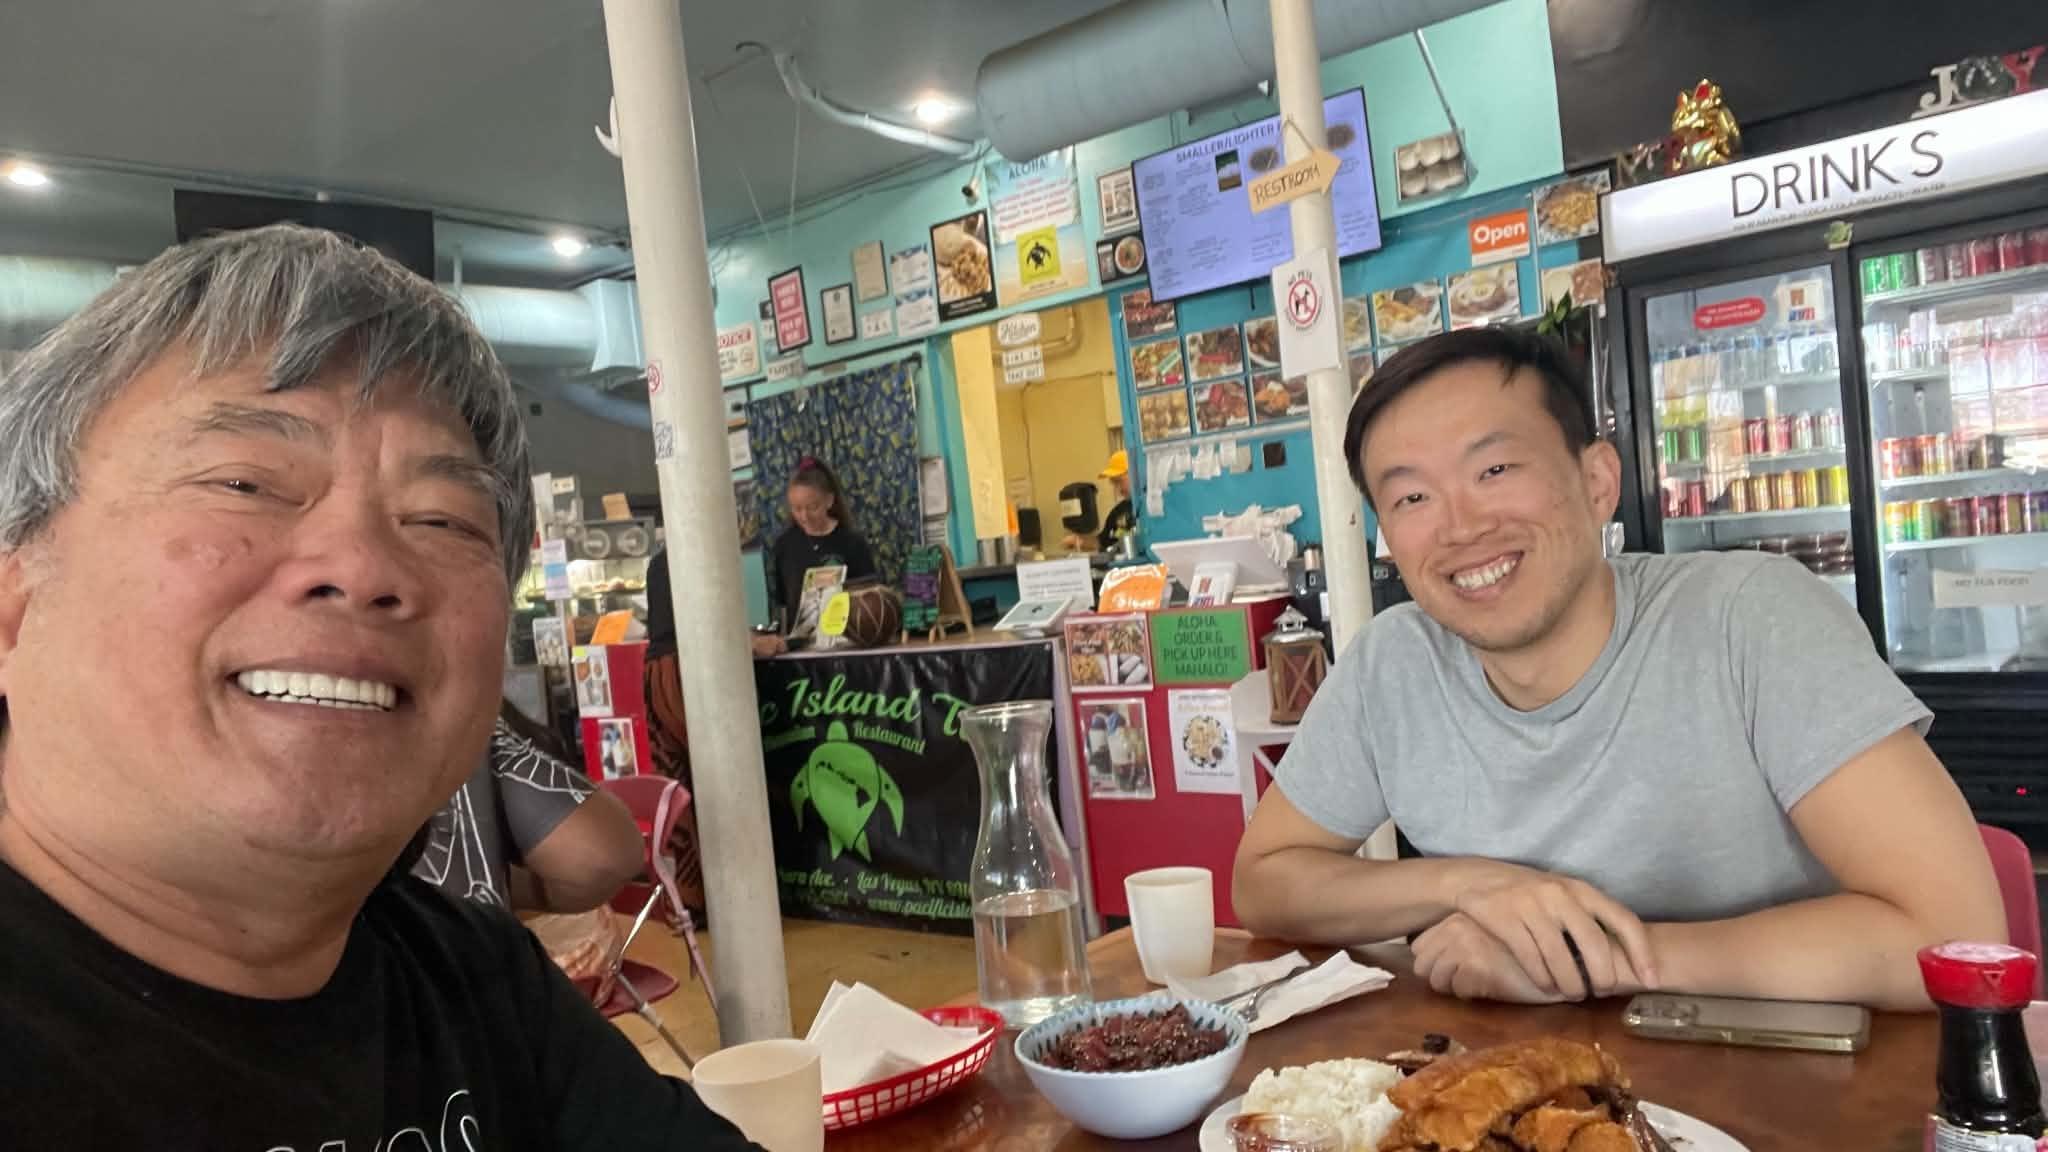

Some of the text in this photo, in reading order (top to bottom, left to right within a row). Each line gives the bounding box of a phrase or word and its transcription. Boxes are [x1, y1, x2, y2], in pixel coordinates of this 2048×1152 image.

[1176, 123, 1275, 163] SMALLER/LIGHTER
[1253, 161, 1321, 205] RESTROOM
[1731, 130, 1944, 219] DRINKS
[1473, 221, 1527, 247] Open
[1177, 615, 1217, 630] ALOHA
[1174, 630, 1212, 646] ORDER
[1175, 662, 1229, 677] MAHALO!
[785, 672, 921, 724] Island
[853, 721, 927, 756] Restaurant
[856, 871, 879, 892] Las
